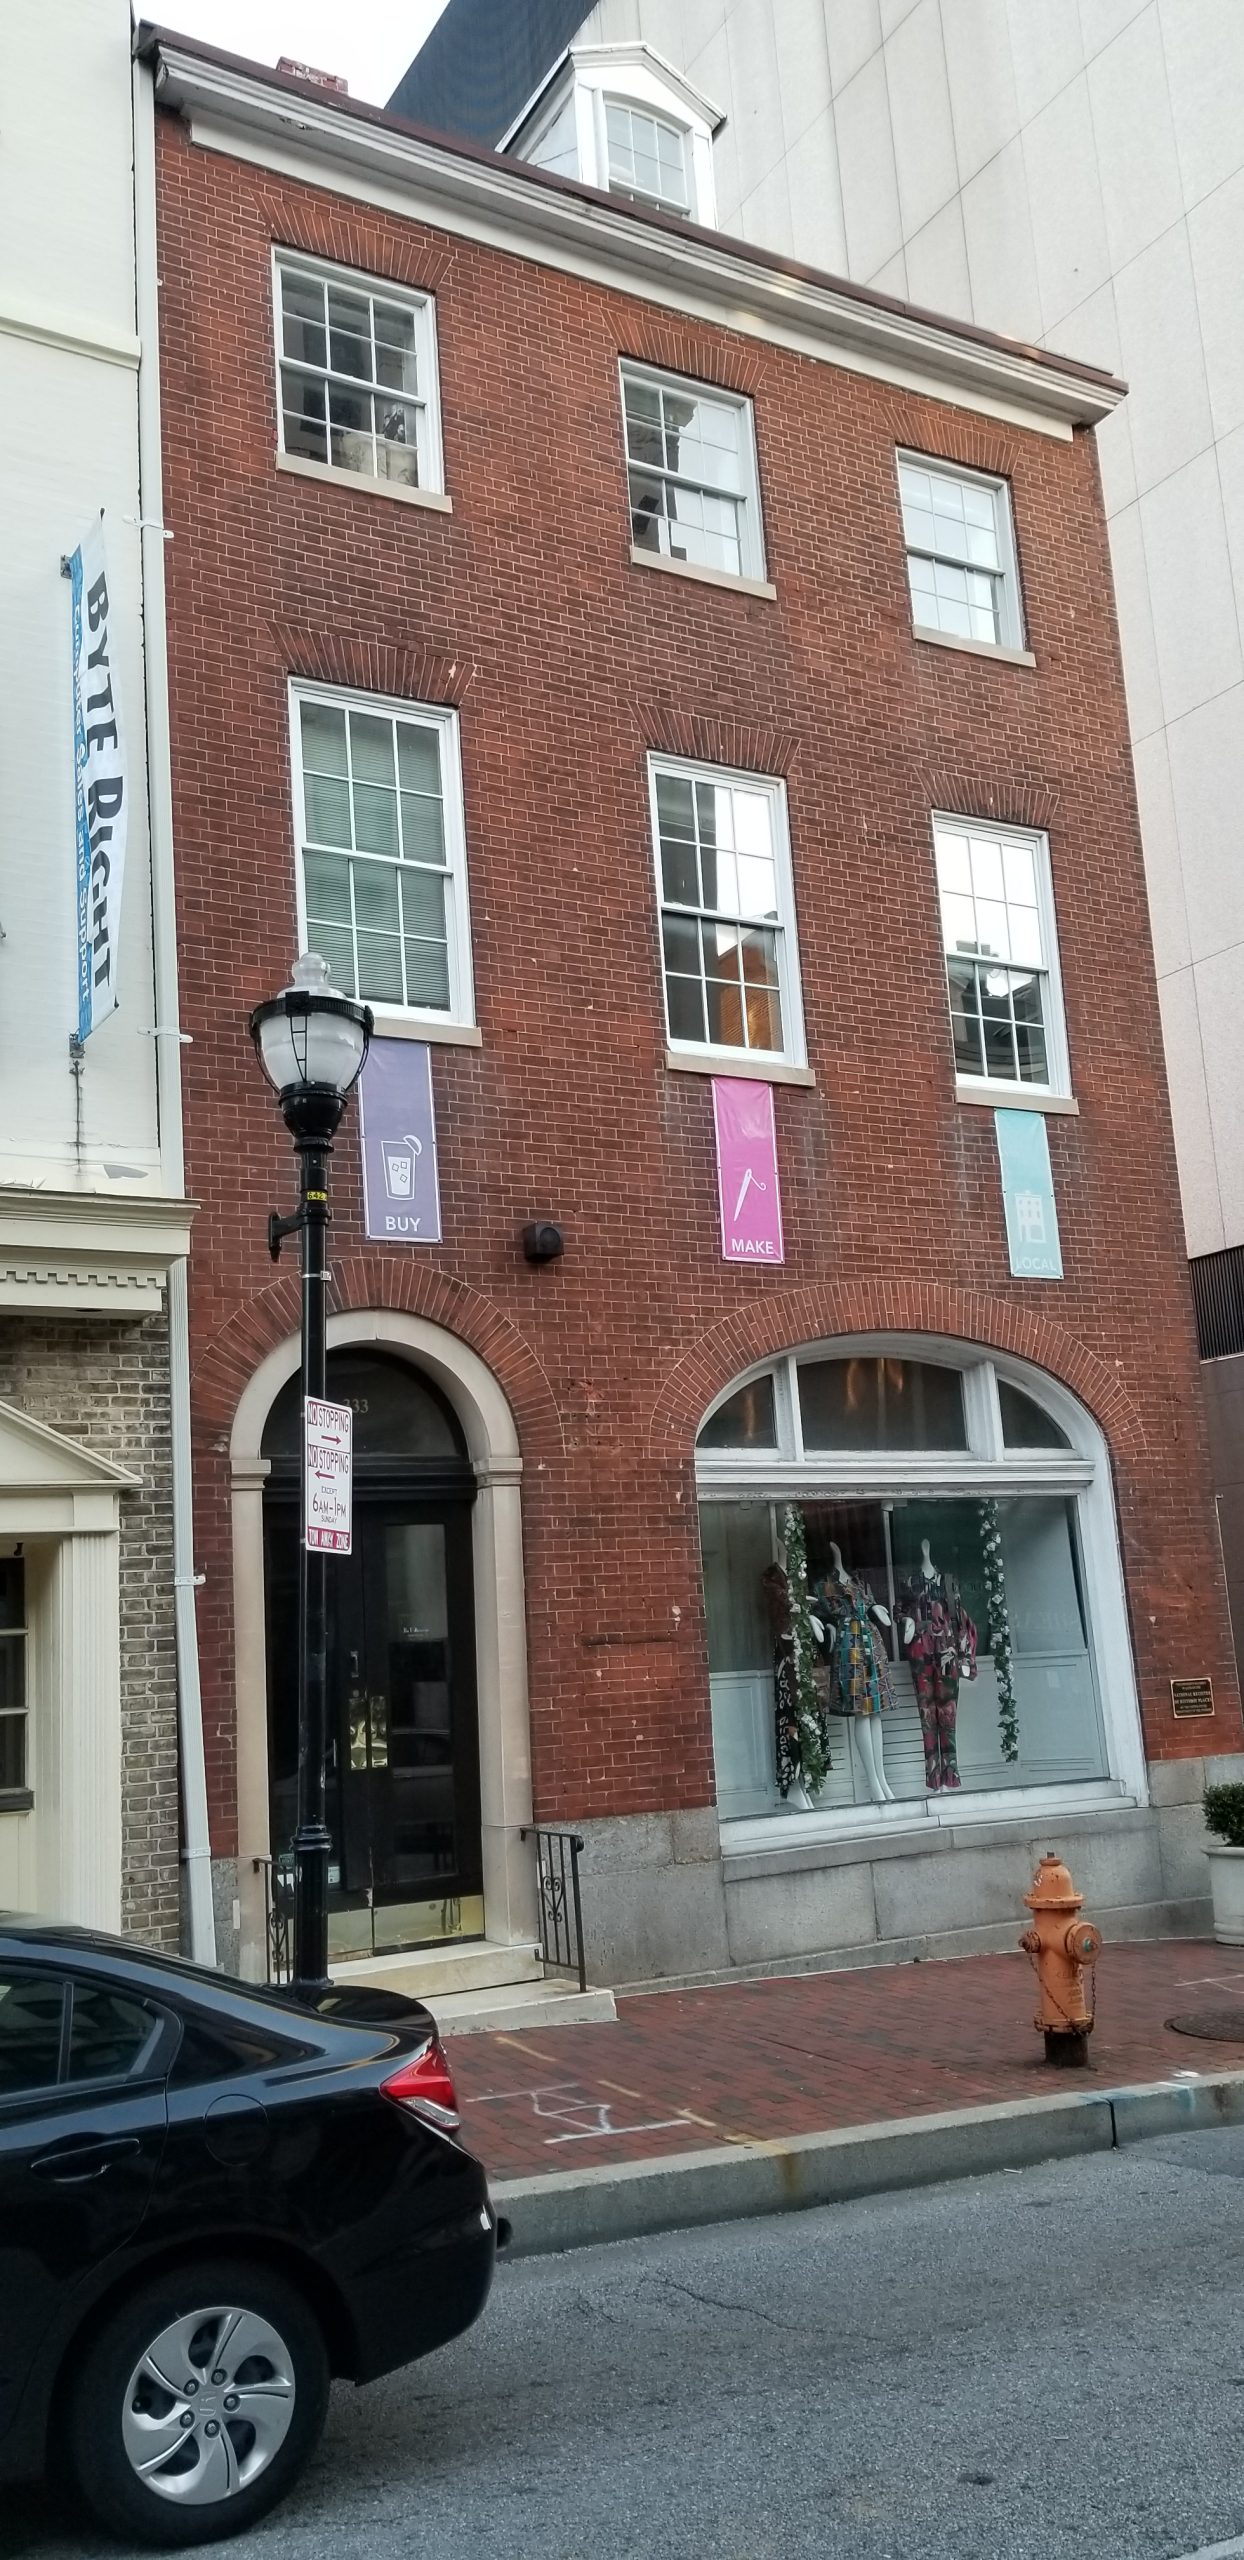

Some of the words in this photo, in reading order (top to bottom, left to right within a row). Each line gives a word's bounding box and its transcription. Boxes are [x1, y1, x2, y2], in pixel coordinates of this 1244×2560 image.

[87, 570, 118, 758] BYTE
[78, 829, 87, 882] and
[88, 776, 123, 988] RIGHT
[79, 888, 89, 1002] Support
[385, 1216, 421, 1232] BUY
[732, 1238, 775, 1255] MAKE
[1016, 1257, 1057, 1271] LOCAL
[308, 1404, 317, 1425] NO
[319, 1407, 348, 1433] STOPPING
[308, 1446, 317, 1467] NO
[319, 1449, 348, 1474] STOPPING
